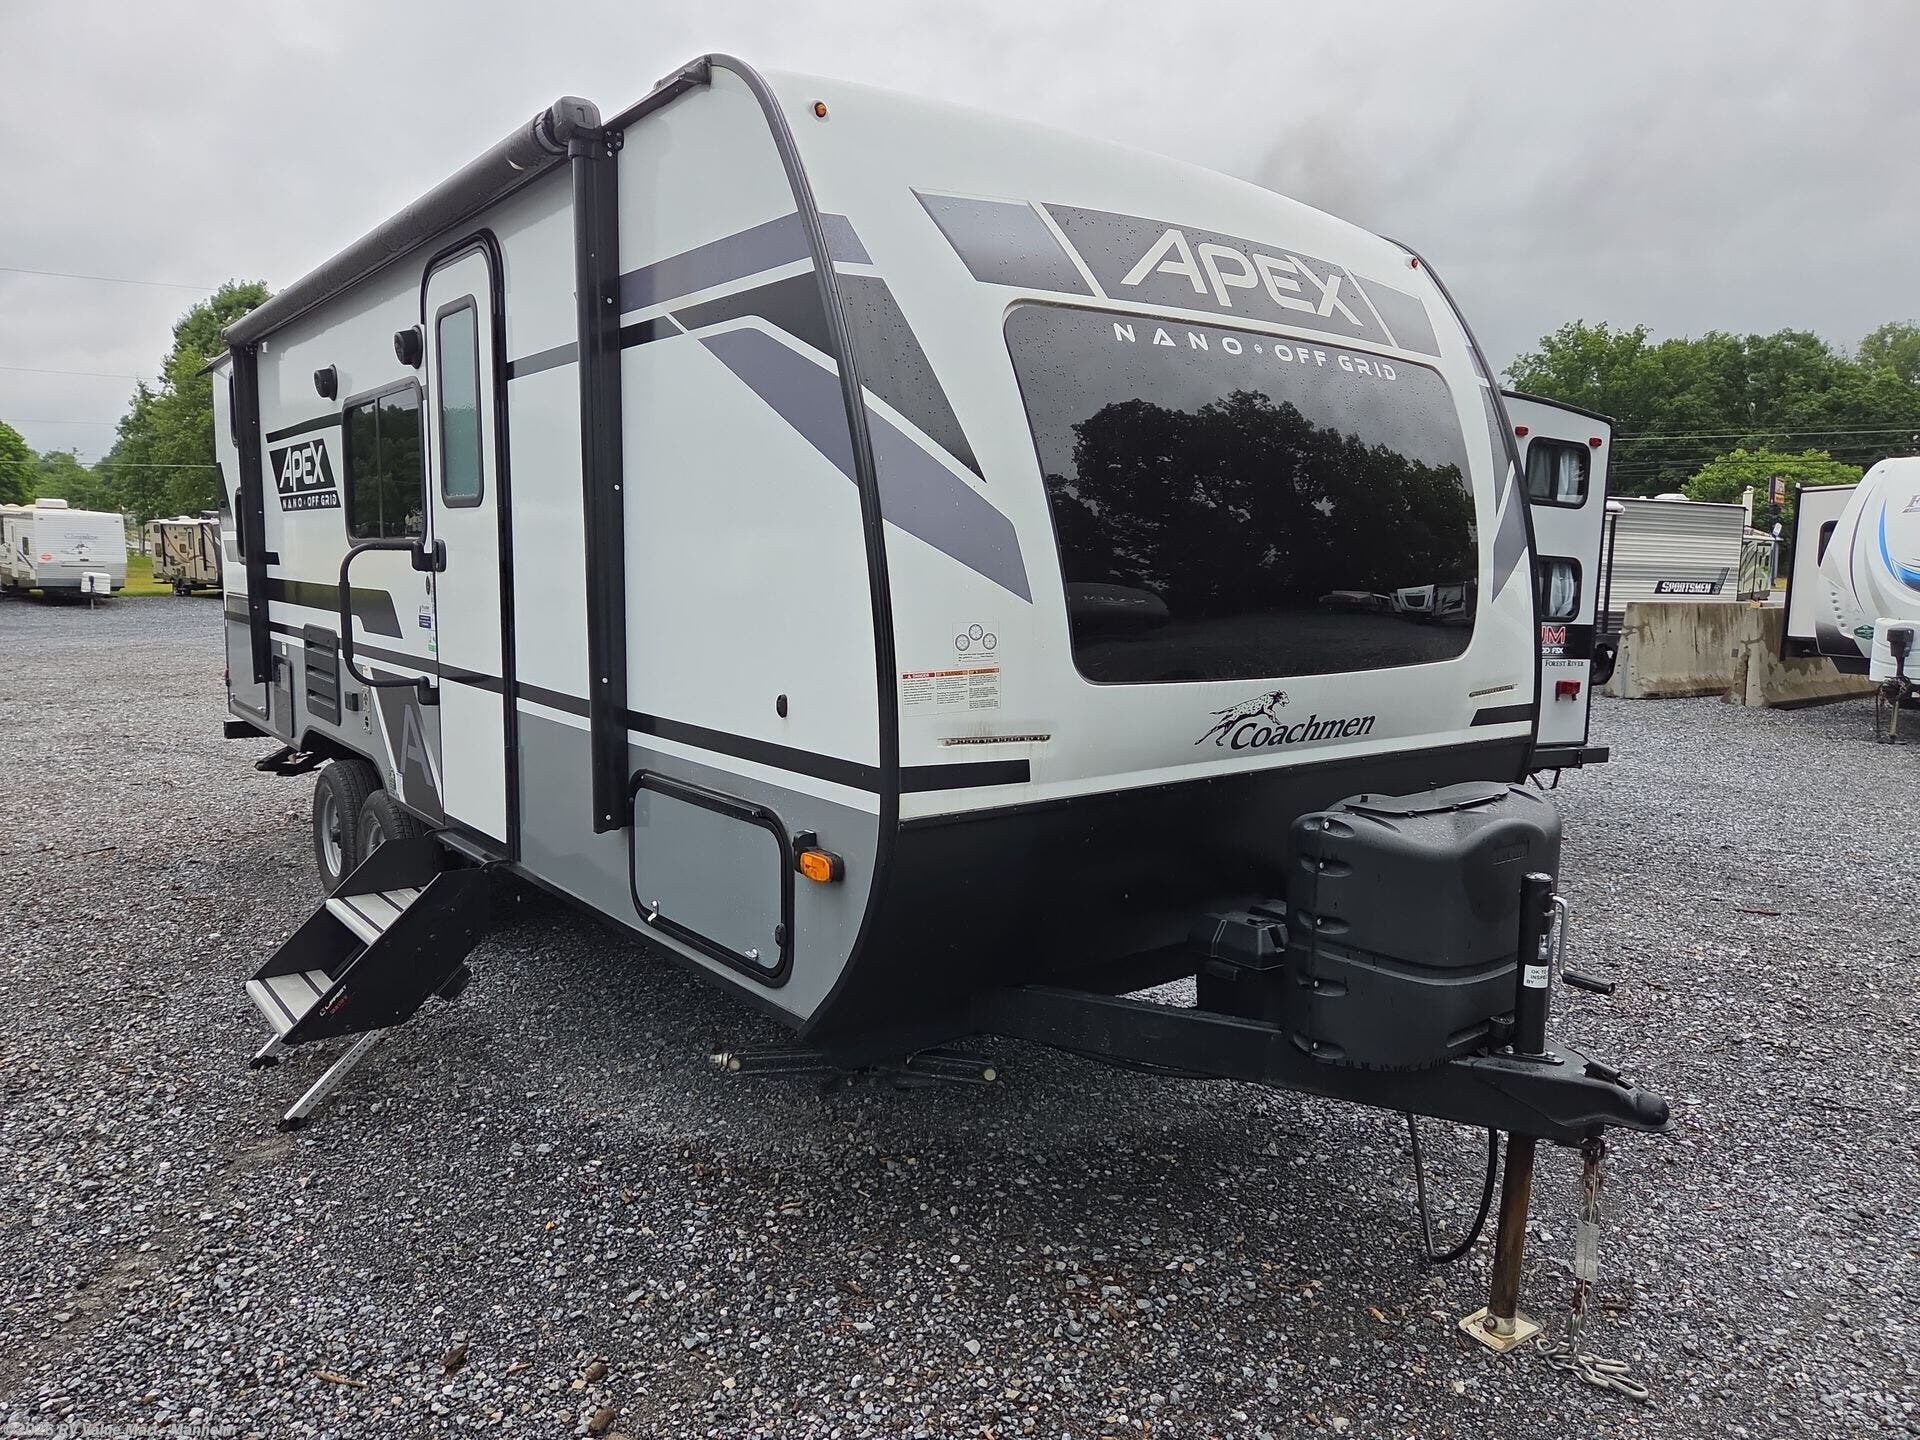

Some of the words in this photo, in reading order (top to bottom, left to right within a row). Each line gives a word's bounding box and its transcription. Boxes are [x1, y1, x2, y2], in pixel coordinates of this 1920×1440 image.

[1120, 228, 1364, 327] APEX
[1113, 322, 1243, 355] NANO
[1274, 344, 1327, 367] OFF
[1338, 355, 1397, 381] GRID
[280, 441, 325, 492] APEX
[282, 497, 303, 509] NANO
[307, 495, 319, 507] OFF
[320, 493, 337, 506] GRID
[1660, 581, 1711, 593] SPORTSMEN
[1230, 713, 1376, 750] Coachmen
